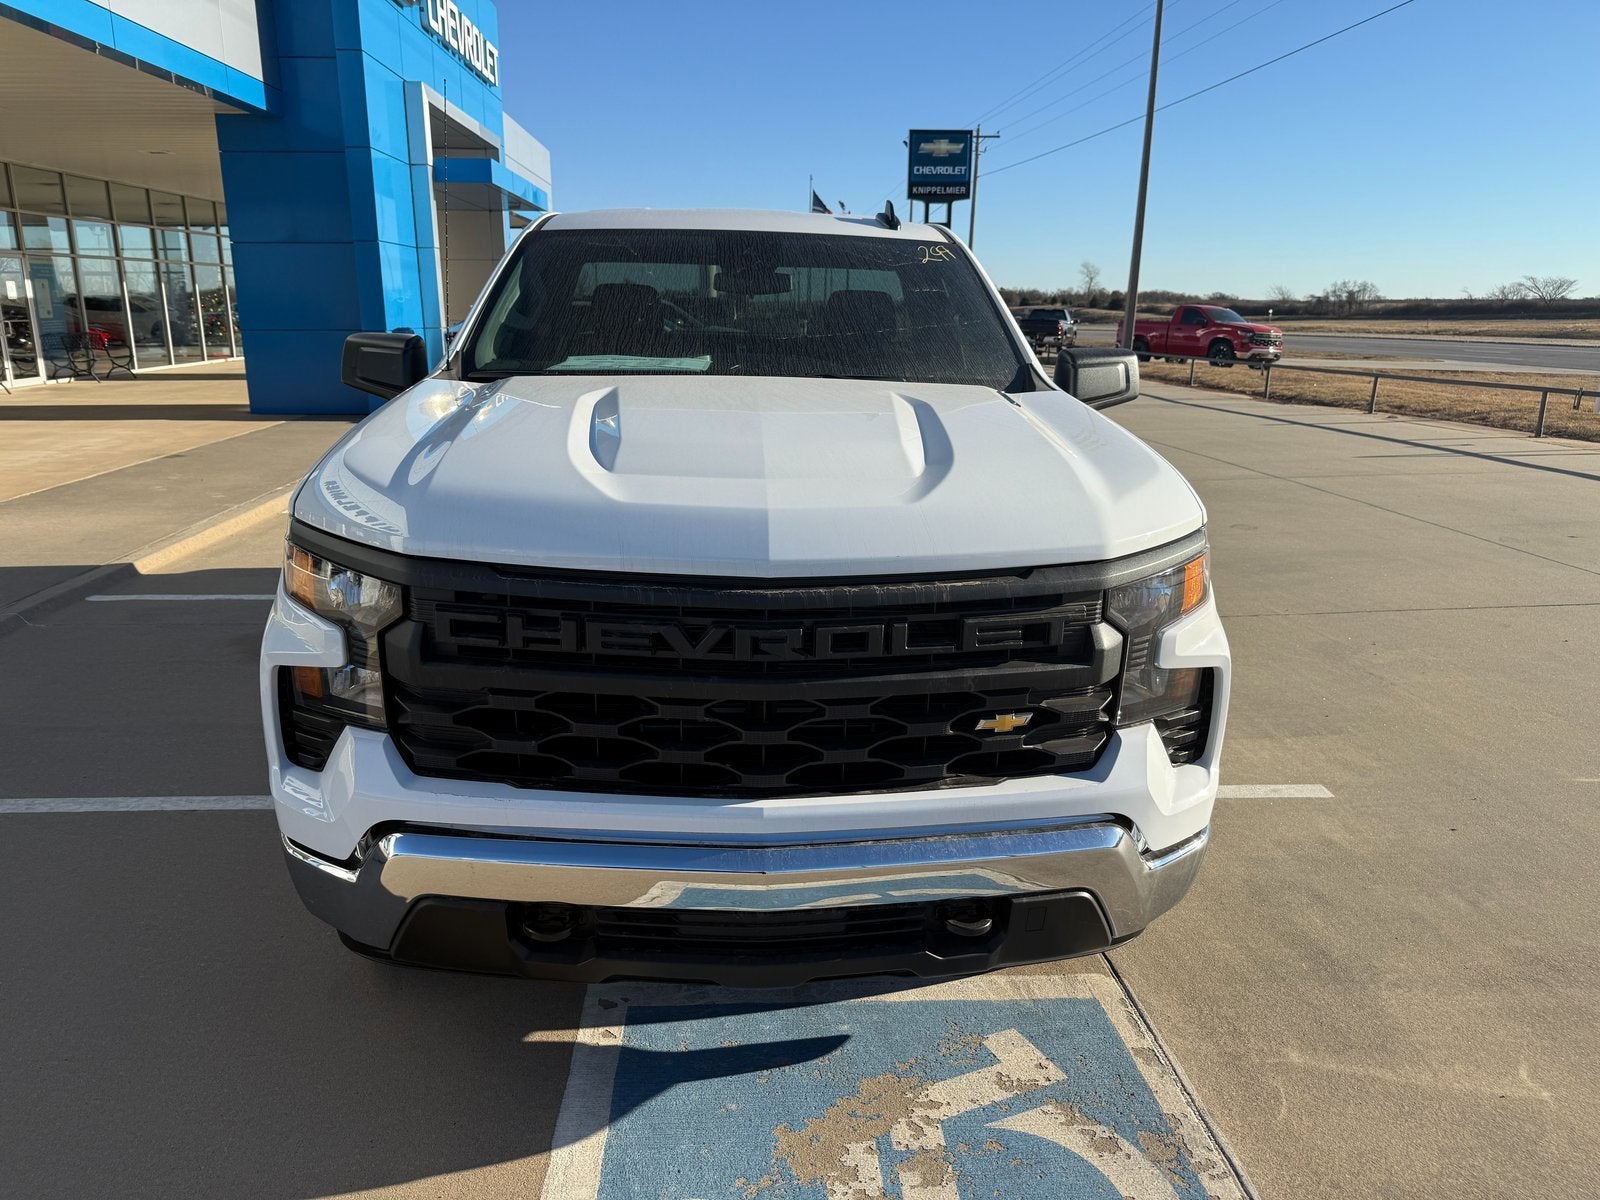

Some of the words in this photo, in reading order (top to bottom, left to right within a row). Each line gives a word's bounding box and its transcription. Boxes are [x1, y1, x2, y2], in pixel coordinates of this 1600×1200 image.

[427, 0, 499, 87] CHEVROLET
[913, 165, 967, 175] CHEVROLET
[912, 186, 966, 195] KNIPPELMIER
[435, 602, 1087, 661] CHEVROLET
